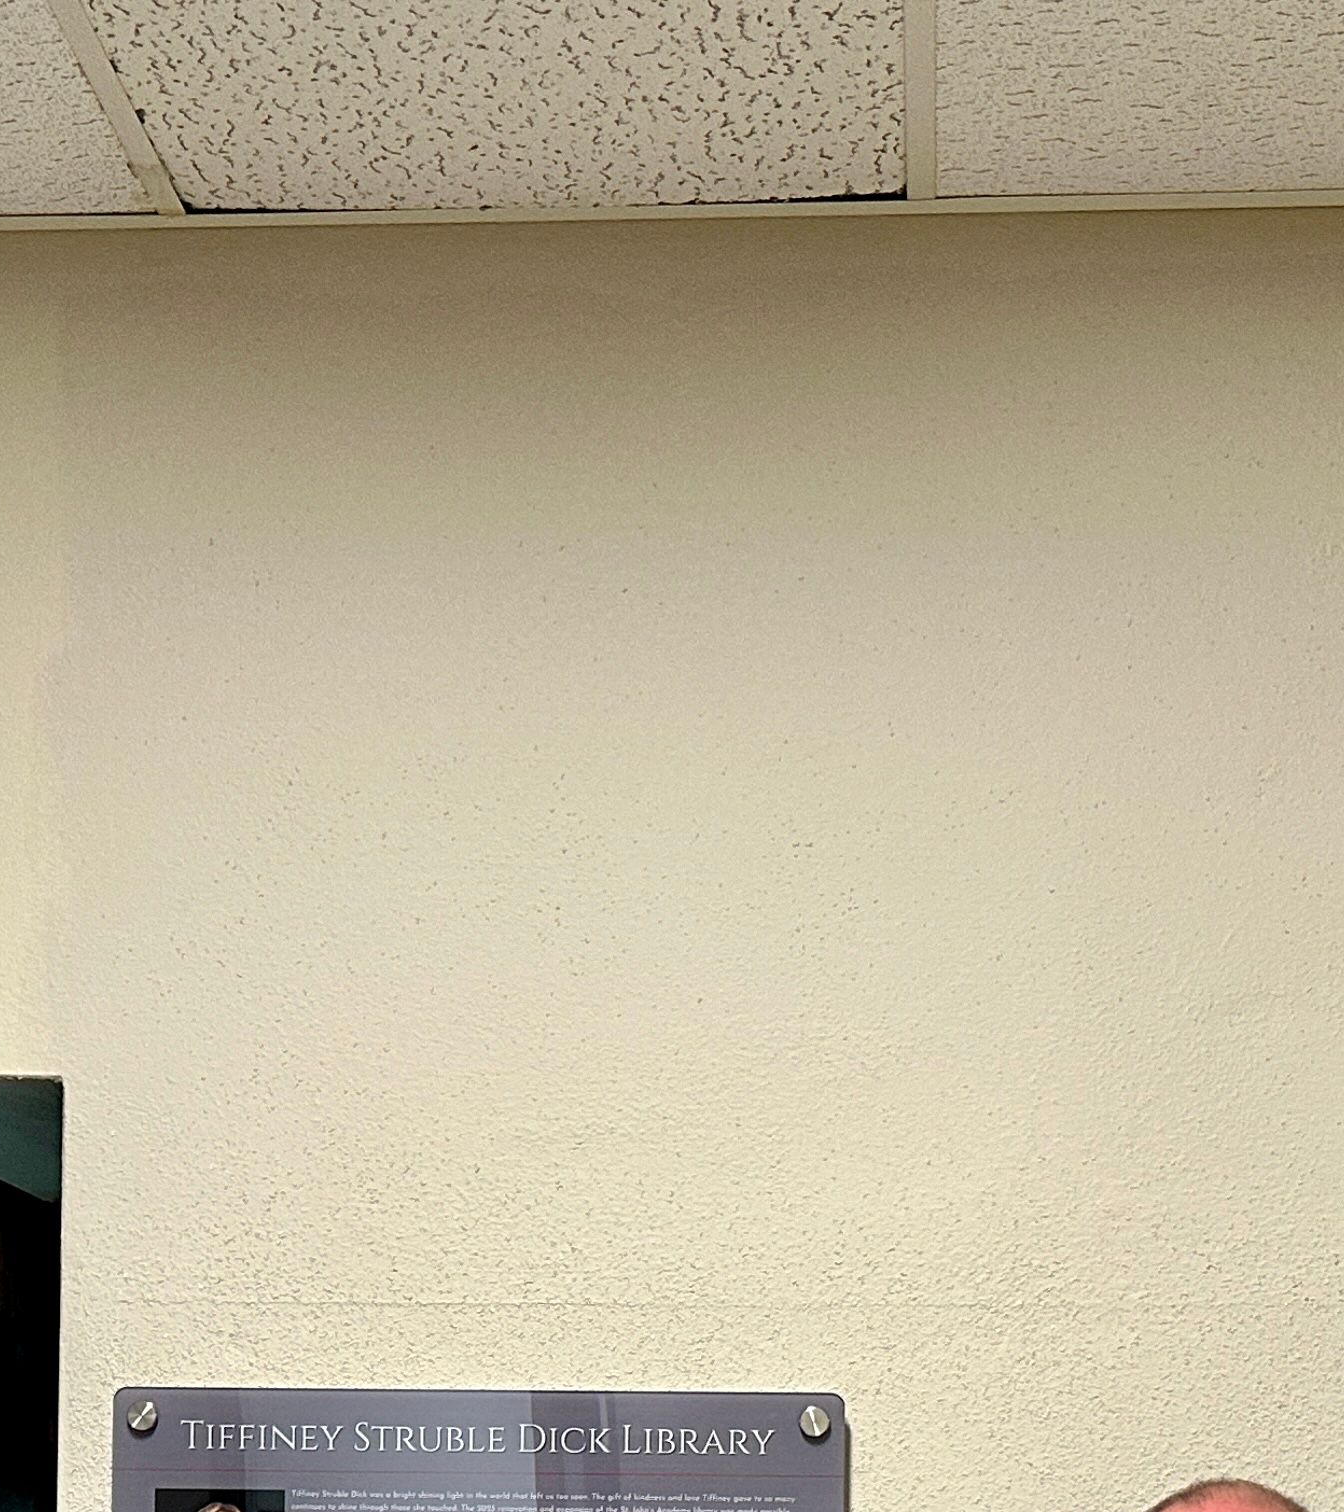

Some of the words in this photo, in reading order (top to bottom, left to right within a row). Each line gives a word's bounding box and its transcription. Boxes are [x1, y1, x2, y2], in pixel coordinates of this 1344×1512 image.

[180, 1419, 344, 1450] TIFFINEY
[354, 1421, 506, 1453] STRUBLE
[518, 1423, 612, 1454] DICK
[622, 1424, 776, 1455] LIBRARY
[292, 1490, 319, 1500] Tiffiney
[684, 1493, 700, 1502] love
[703, 1493, 730, 1504] Tiffiney
